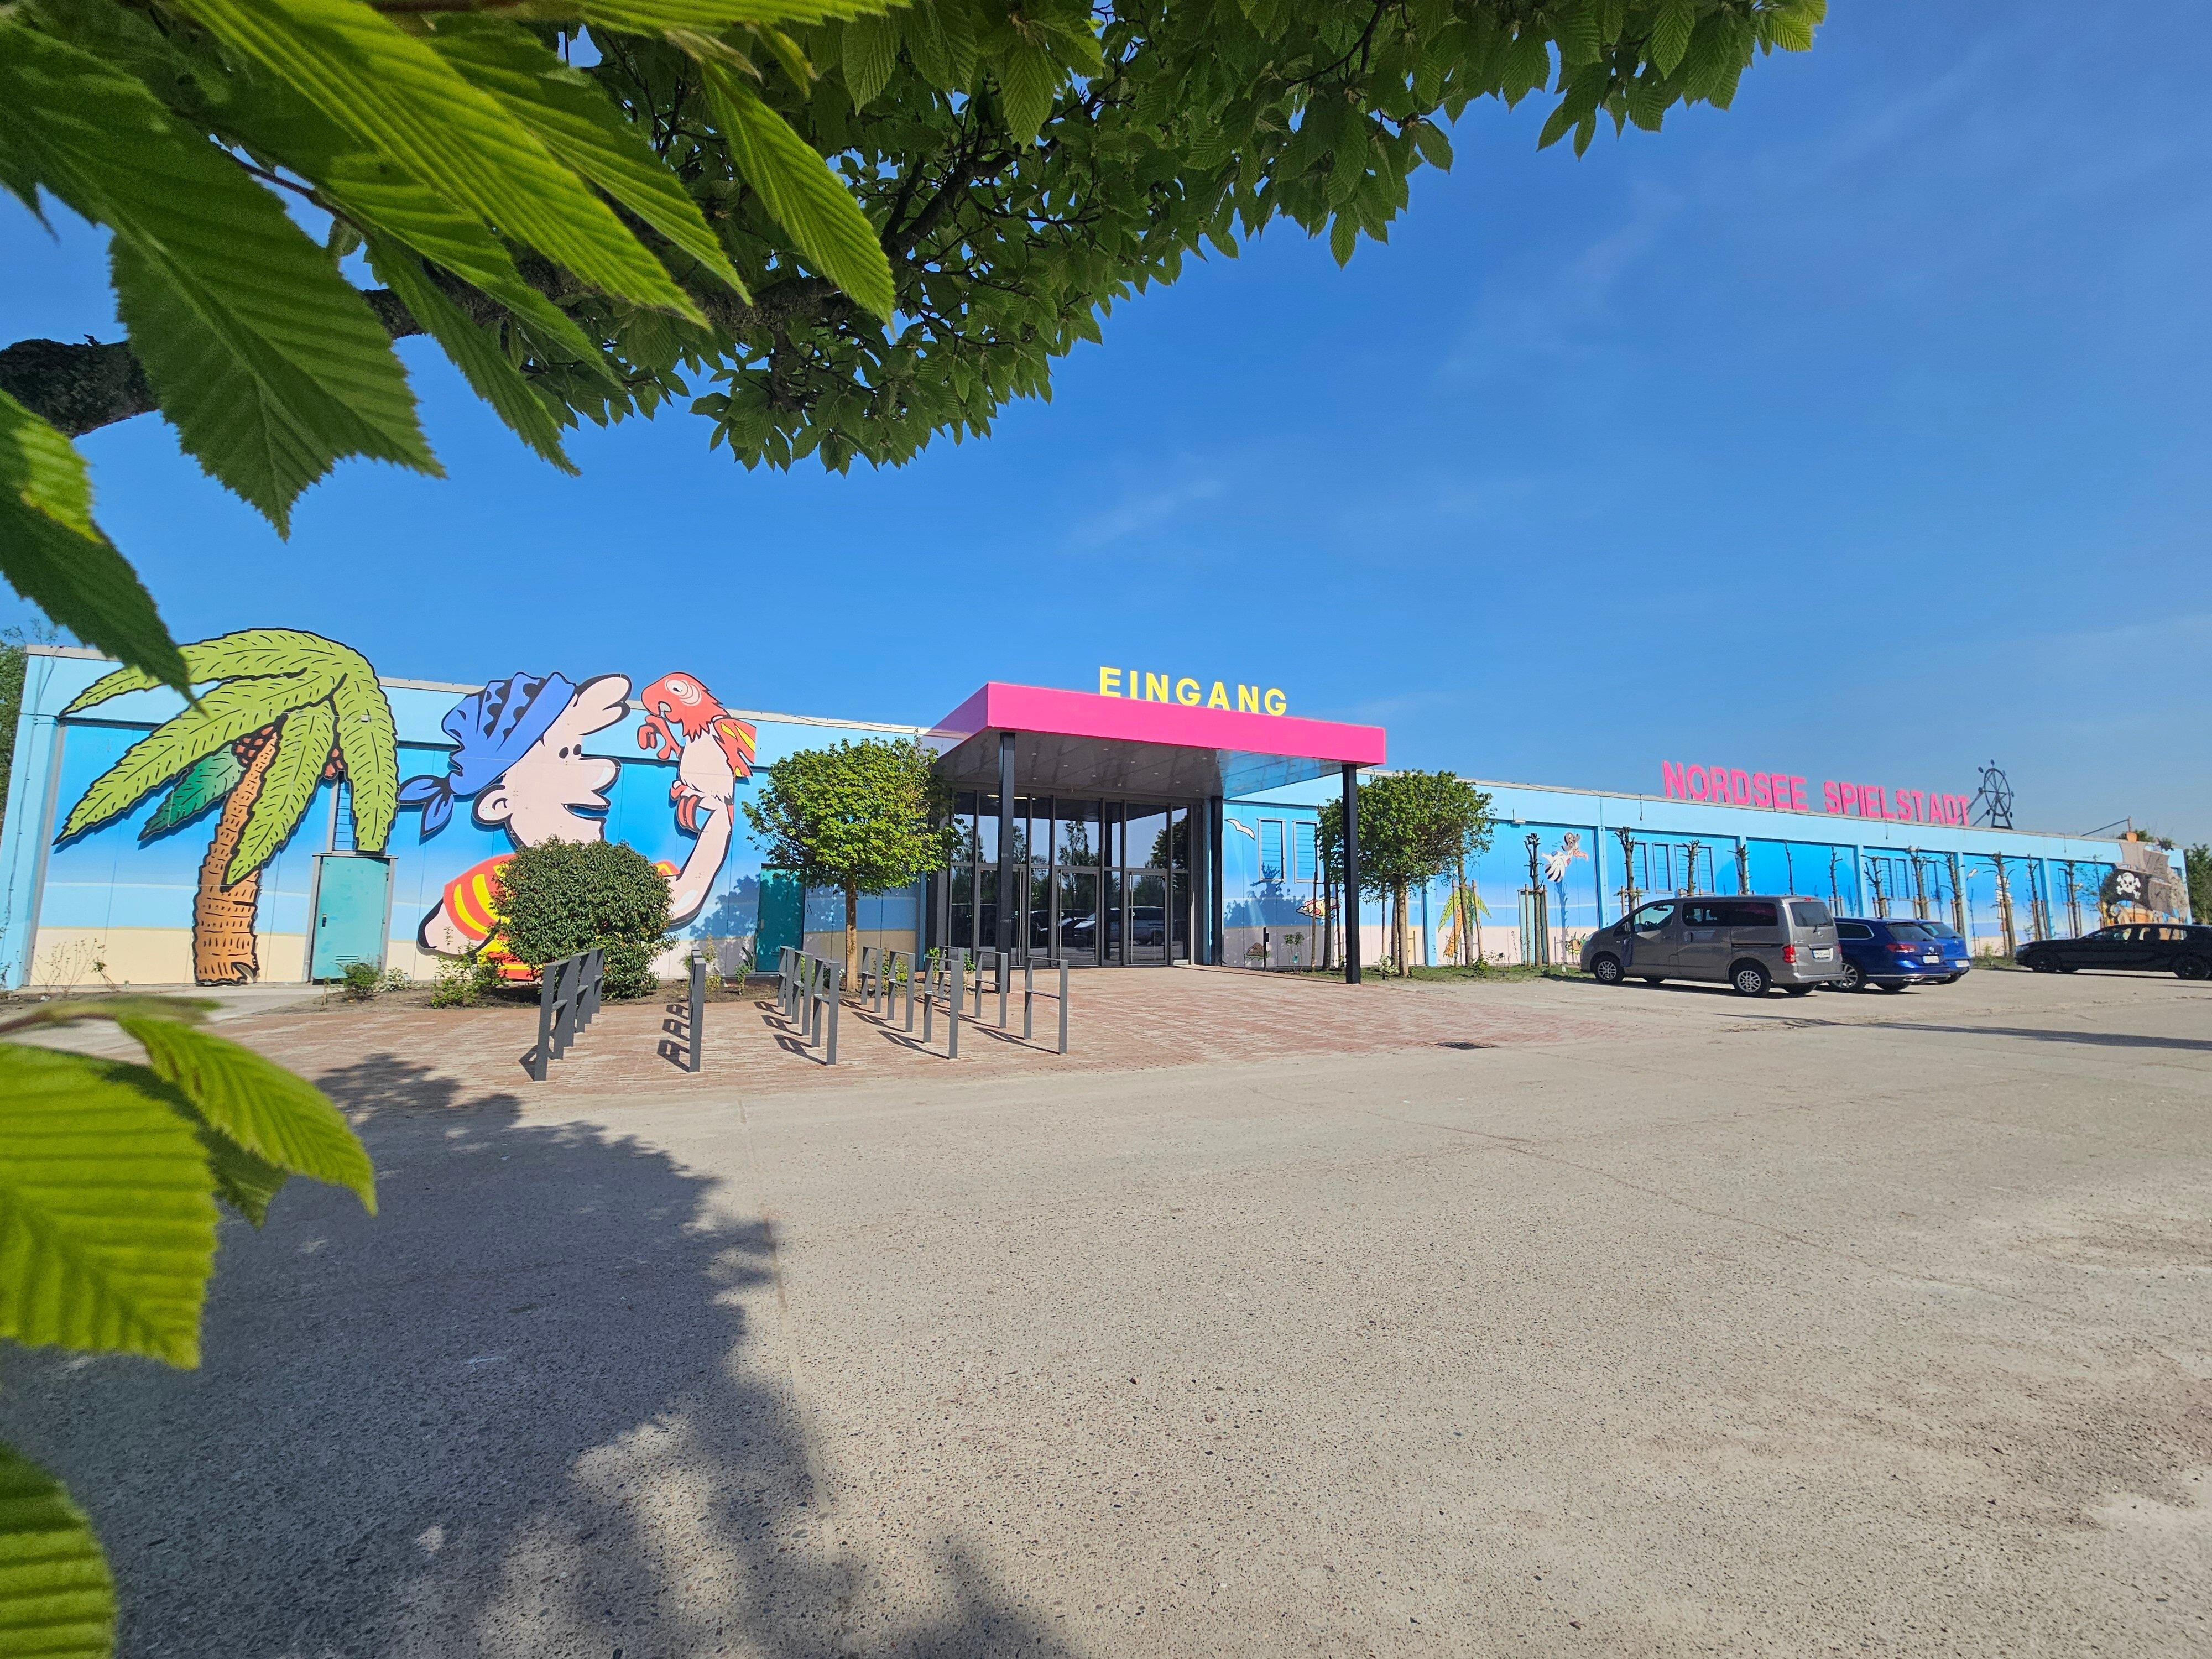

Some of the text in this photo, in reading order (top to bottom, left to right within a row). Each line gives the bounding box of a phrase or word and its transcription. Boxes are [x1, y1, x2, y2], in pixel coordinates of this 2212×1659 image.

[1100, 666, 1287, 717] EINGANG
[1662, 760, 1970, 826] NORDSEE SPIELSTADT
